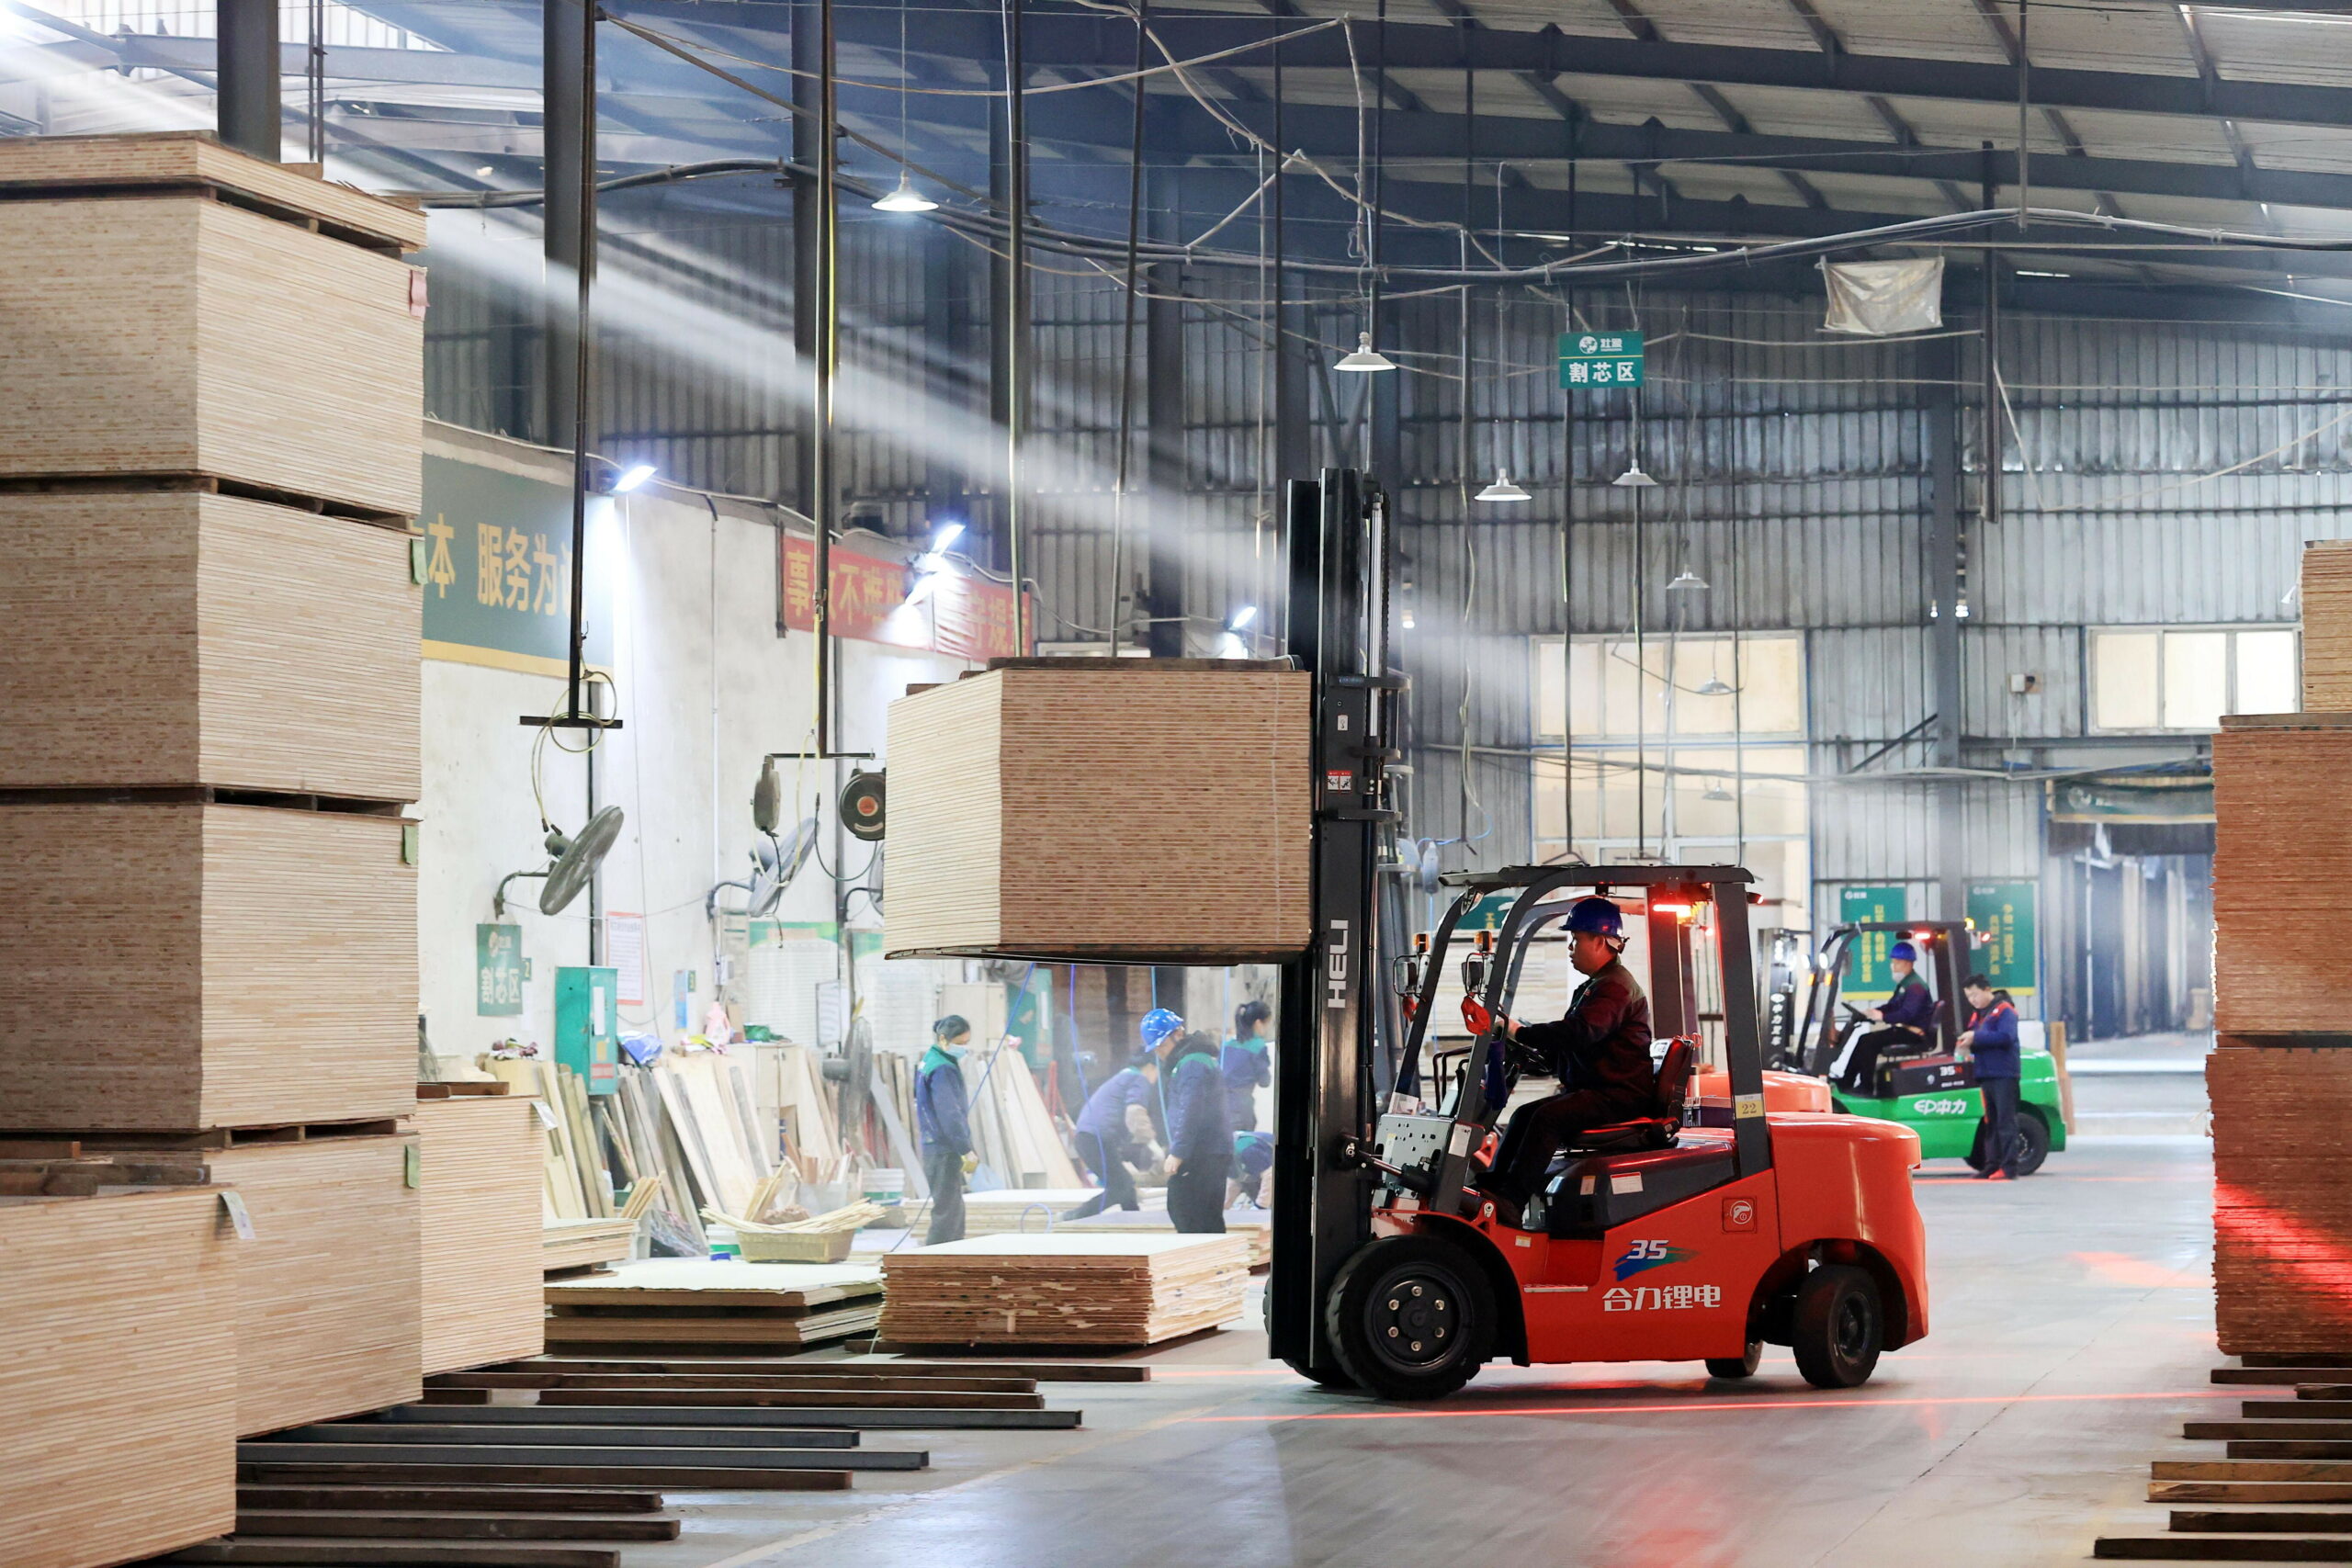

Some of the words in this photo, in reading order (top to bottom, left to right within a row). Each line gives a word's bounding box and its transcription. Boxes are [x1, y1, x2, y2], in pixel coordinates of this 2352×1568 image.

[1568, 362, 1635, 383] 割芯区
[415, 513, 456, 599] 本
[1328, 919, 1349, 1009] HELI
[1742, 1103, 1758, 1114] 22
[1626, 1239, 1669, 1259] 35
[1602, 1284, 1721, 1312] 合力锂电
